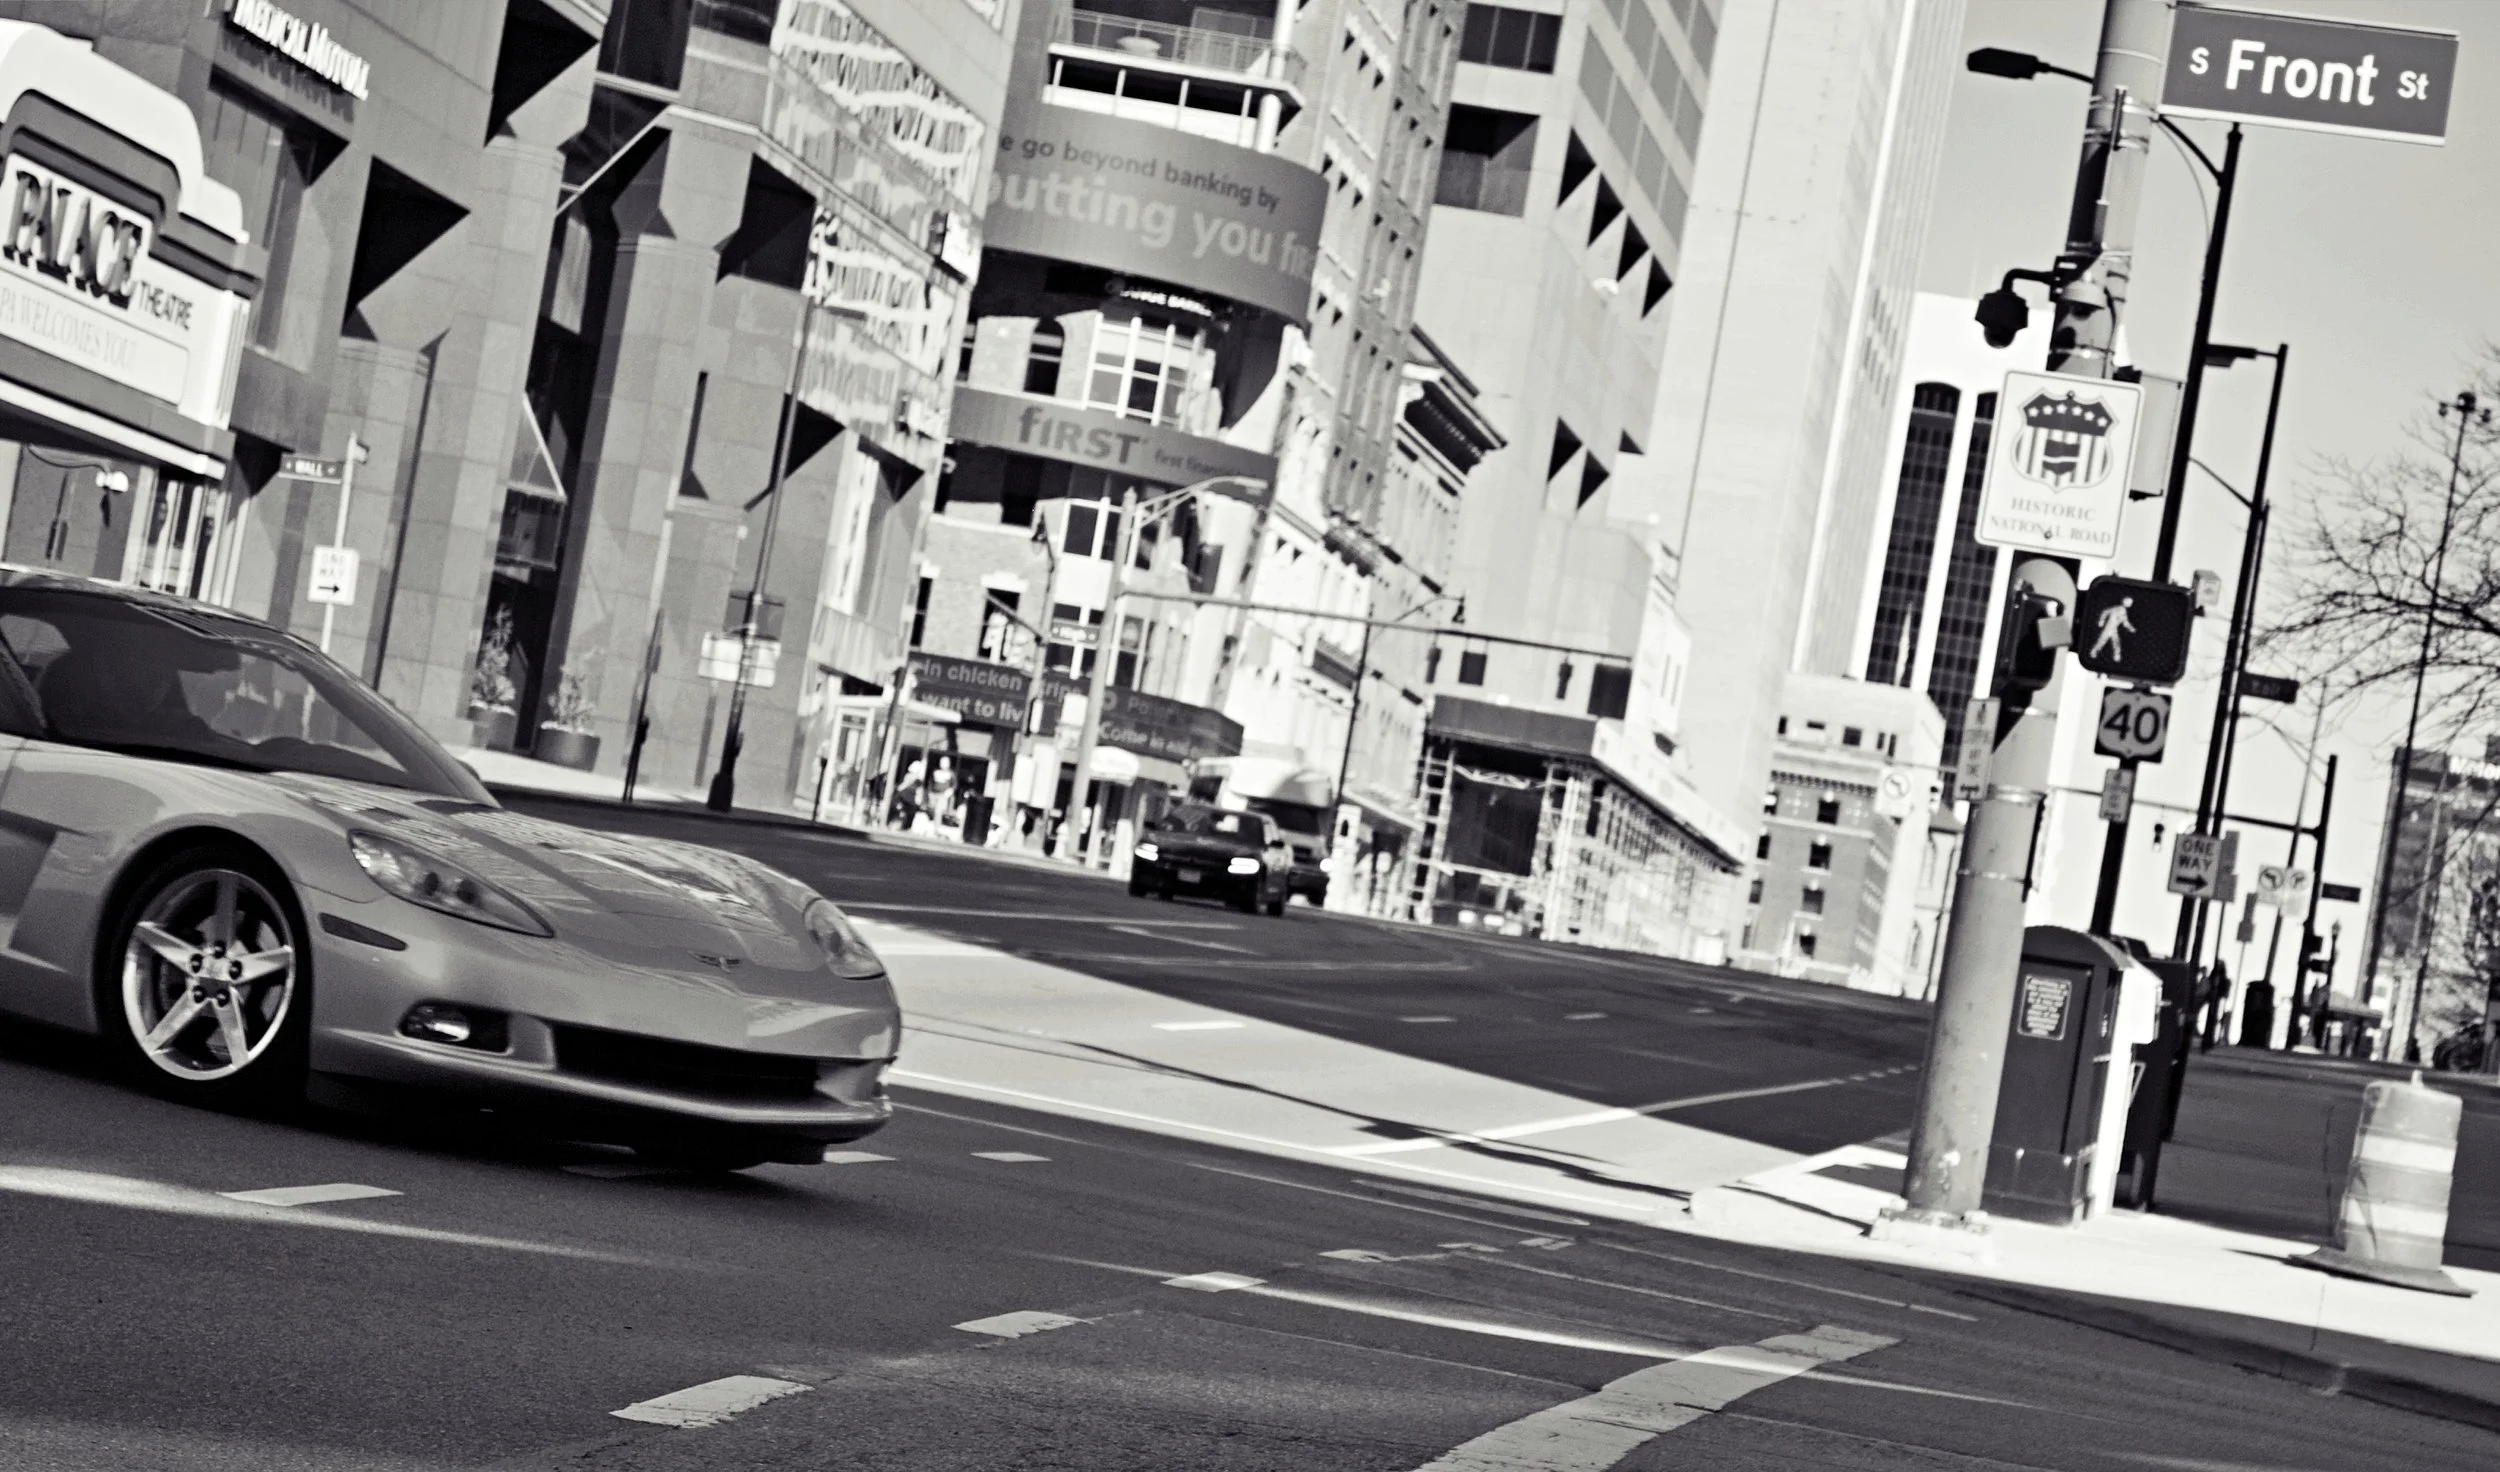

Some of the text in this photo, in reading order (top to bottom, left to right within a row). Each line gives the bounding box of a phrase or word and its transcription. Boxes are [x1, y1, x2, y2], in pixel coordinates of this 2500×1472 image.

[2225, 38, 2379, 106] Front
[2397, 70, 2430, 101] St
[1022, 137, 1055, 159] go
[1063, 140, 1157, 178] beyond
[1164, 160, 1254, 207] banking
[1257, 190, 1281, 215] by
[3, 170, 143, 311] PALACE
[1192, 211, 1273, 266] you
[139, 280, 194, 331] THEATRE
[20, 293, 102, 358] WELCOMES
[2010, 498, 2096, 521] HISTORIC
[1991, 515, 2112, 544] NATIONAL ROAD
[318, 567, 345, 581] WAY
[321, 553, 345, 568] ONE
[947, 663, 1022, 692] chicken
[974, 698, 996, 718] to
[998, 700, 1024, 722] liv
[2103, 703, 2160, 745] 40
[1100, 720, 1148, 745] Come
[2182, 837, 2215, 856] ONE
[2178, 854, 2213, 872] WAY
